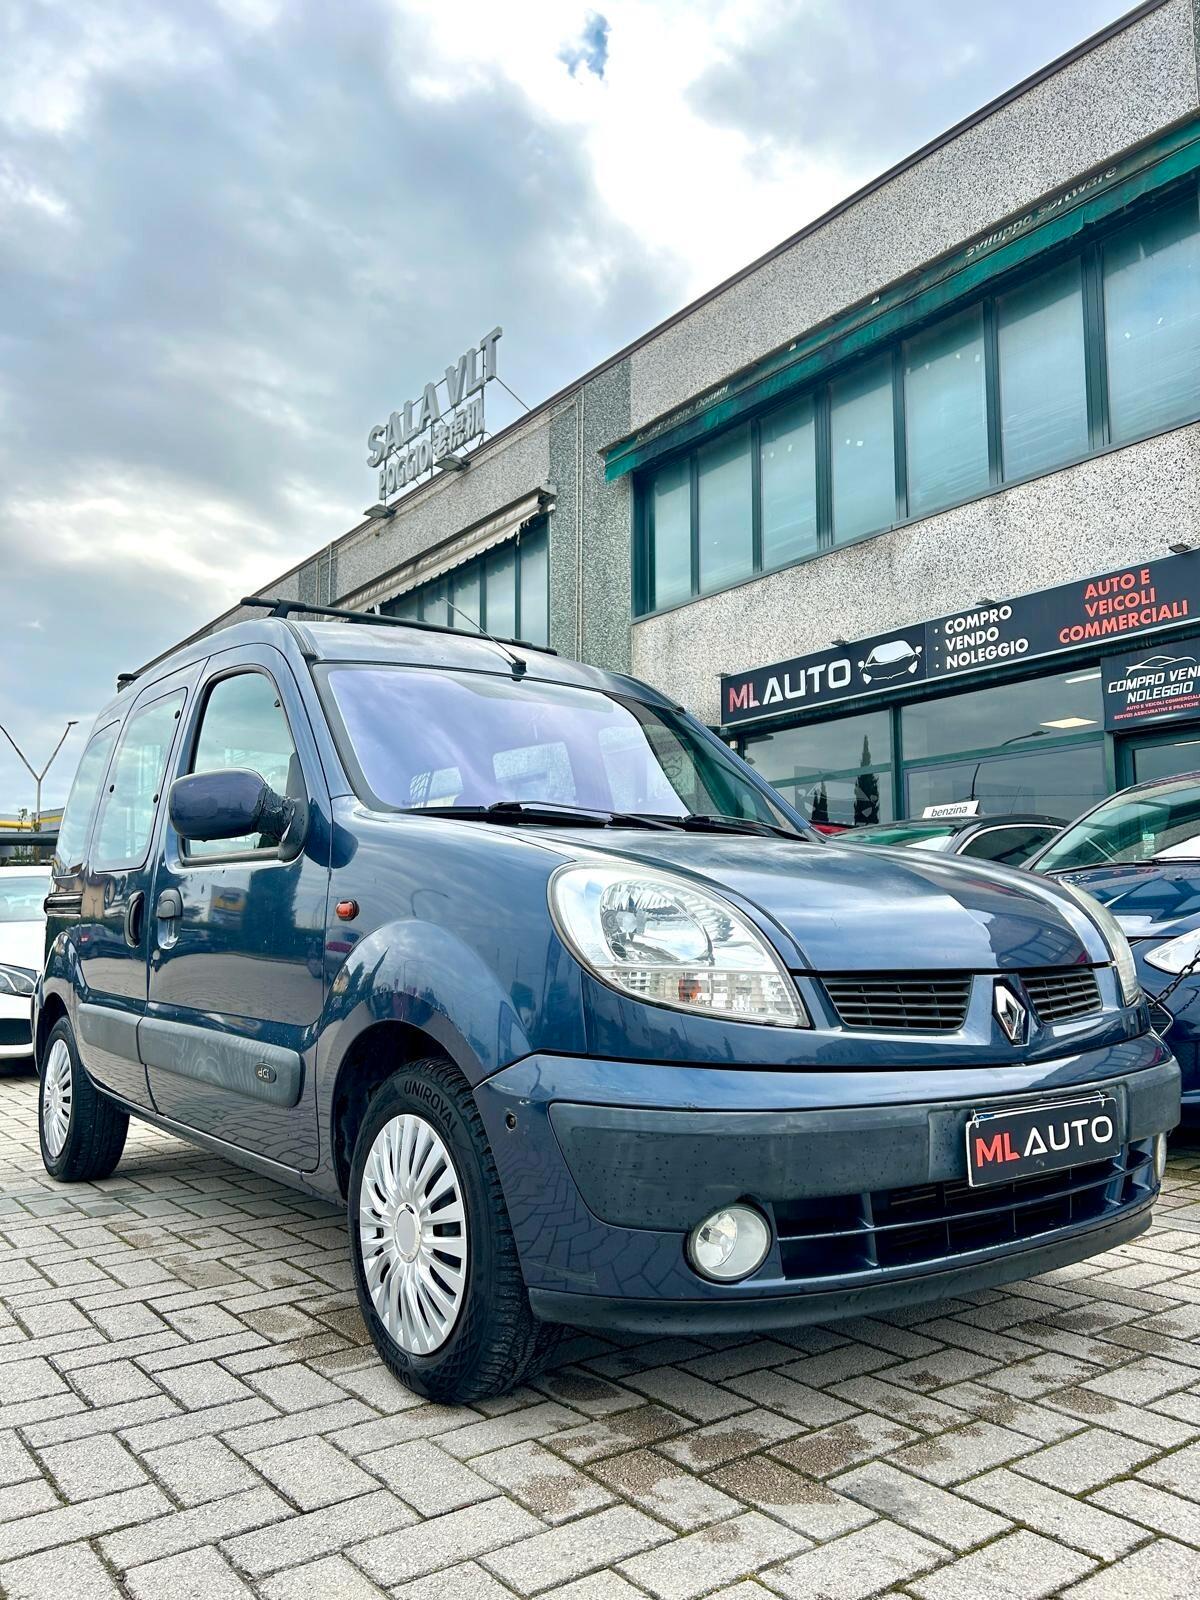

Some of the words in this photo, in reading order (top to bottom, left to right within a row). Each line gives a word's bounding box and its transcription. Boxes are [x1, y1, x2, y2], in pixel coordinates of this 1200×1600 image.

[367, 382, 441, 468] SALA
[445, 326, 503, 408] VLT
[379, 439, 433, 501] POGGIO
[1084, 573, 1136, 600] AUTO
[1141, 568, 1151, 585] E
[1085, 587, 1156, 618] VEICOLI
[944, 605, 1013, 635] COMPRO
[1059, 600, 1189, 644] COMMERCIALI
[945, 626, 999, 652] VENDO
[946, 638, 1029, 670] NOLEGGIO
[729, 682, 760, 712] ML
[763, 658, 852, 705] AUTO
[1108, 672, 1166, 693] COMPRO
[1127, 681, 1194, 704] NOLEGGIO
[1145, 700, 1165, 708] VEICOLI
[931, 806, 968, 817] benzina
[404, 1080, 457, 1138] UNIROYAL
[975, 1132, 1021, 1168] ML
[1024, 1115, 1114, 1157] AUTO
